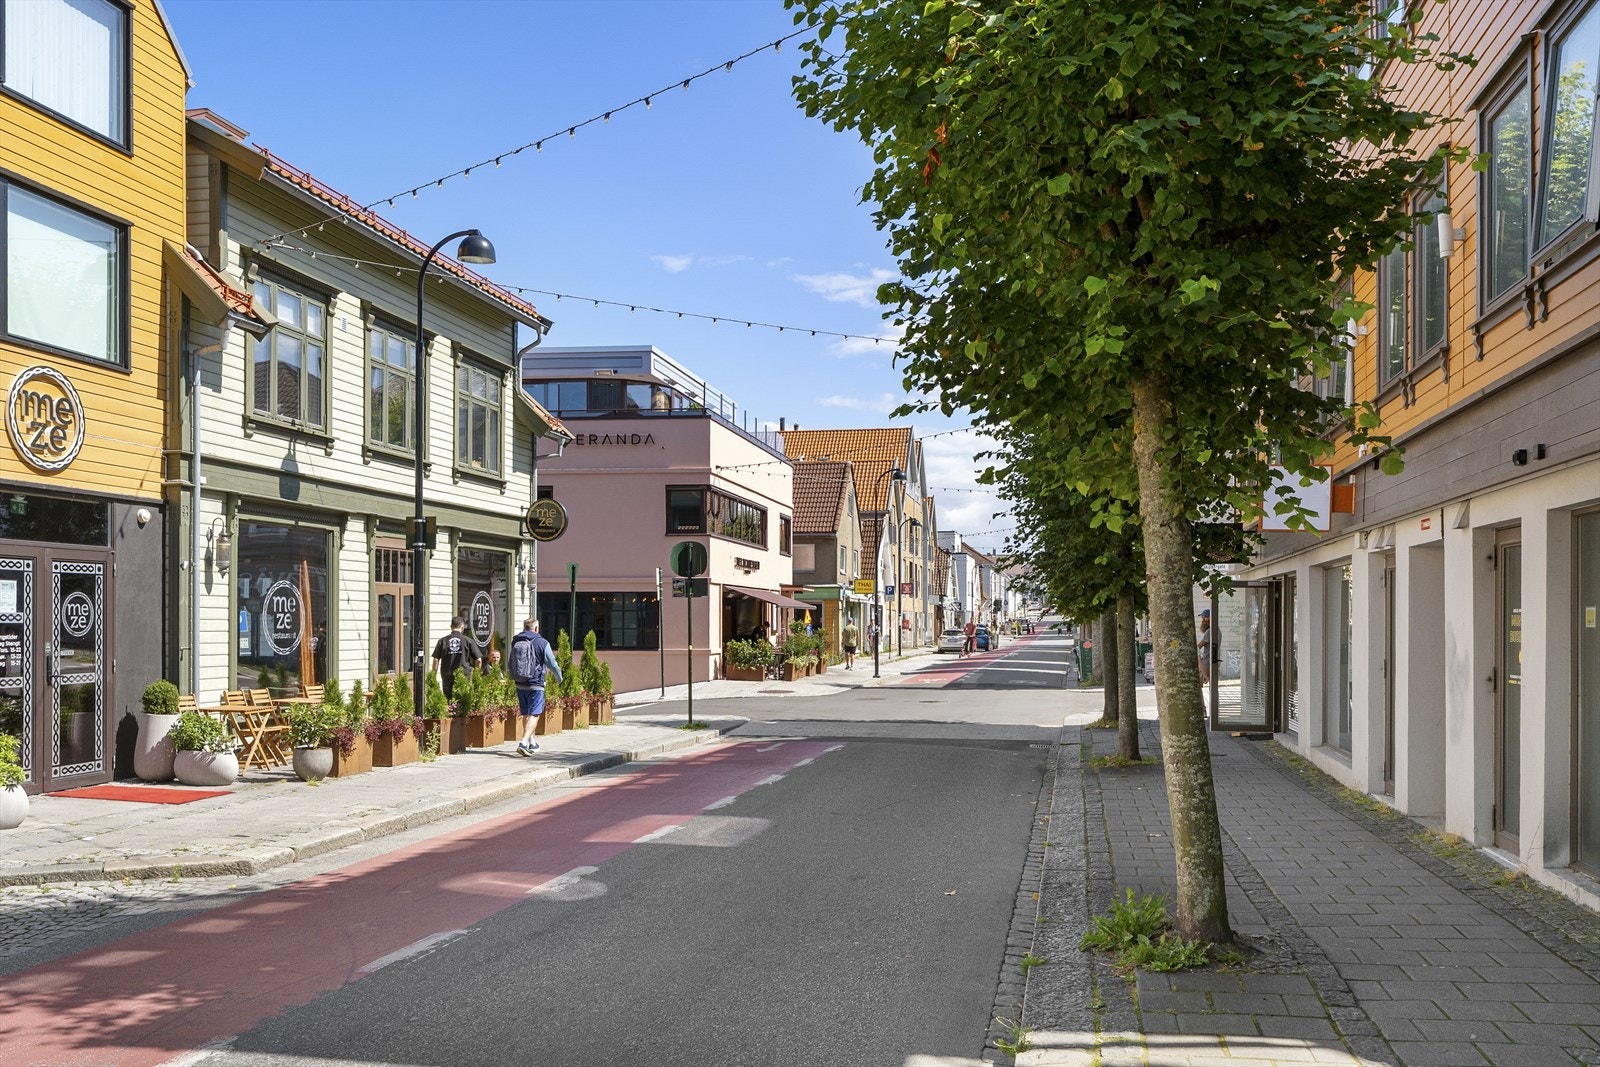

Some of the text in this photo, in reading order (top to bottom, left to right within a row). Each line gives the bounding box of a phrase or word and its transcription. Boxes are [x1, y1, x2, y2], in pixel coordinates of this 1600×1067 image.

[20, 389, 74, 426] me
[29, 420, 67, 452] ze
[575, 433, 655, 446] ERANDA
[536, 508, 557, 518] me
[538, 517, 554, 527] ze
[67, 603, 89, 616] me
[272, 596, 296, 613] me
[476, 602, 490, 616] me
[70, 615, 87, 629] ze
[276, 613, 292, 629] ze
[478, 616, 488, 628] ze
